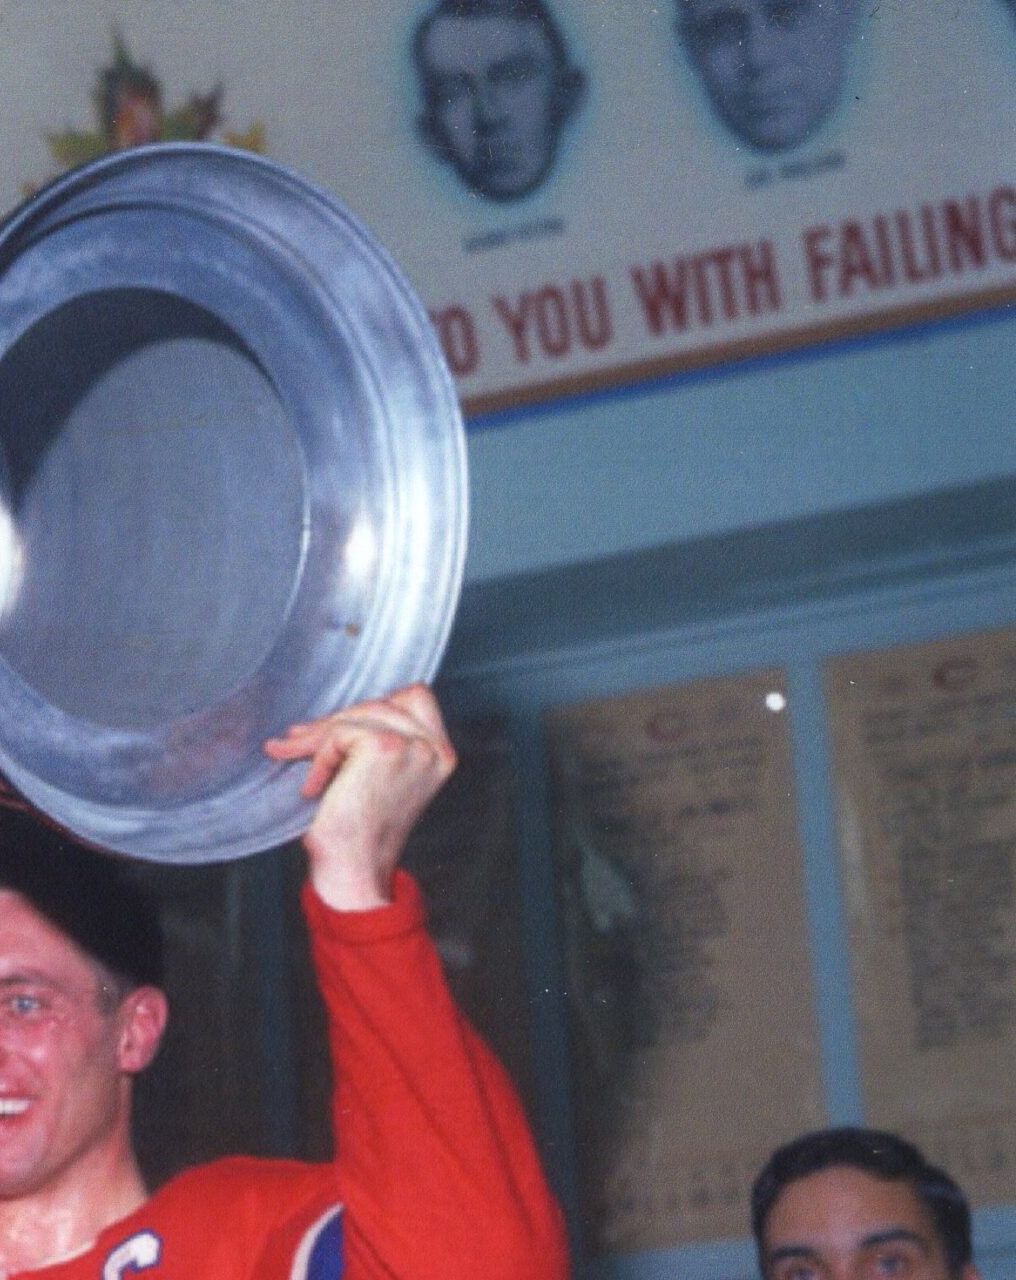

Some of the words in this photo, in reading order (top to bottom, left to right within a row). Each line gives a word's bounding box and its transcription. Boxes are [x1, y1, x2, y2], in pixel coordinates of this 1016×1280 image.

[494, 276, 614, 366] YOU
[630, 239, 782, 339] WITH
[802, 186, 1016, 302] FAILING
